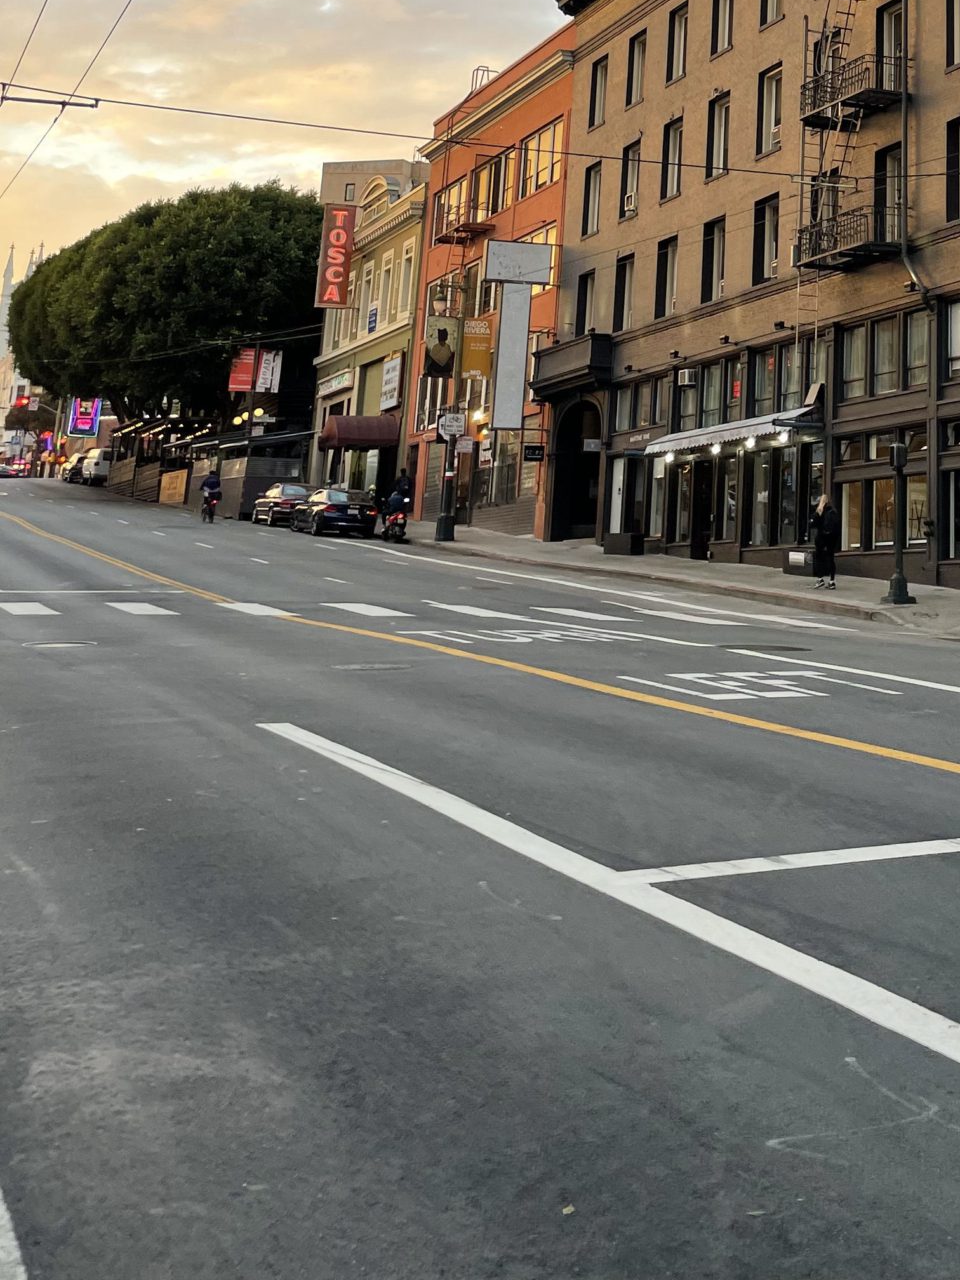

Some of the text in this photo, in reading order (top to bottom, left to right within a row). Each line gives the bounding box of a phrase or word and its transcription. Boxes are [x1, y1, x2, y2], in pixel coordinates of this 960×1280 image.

[323, 210, 349, 302] TOSCA
[464, 320, 489, 328] DIEGO
[464, 327, 491, 335] RIVERA
[396, 629, 644, 644] TURN
[616, 669, 905, 701] LEFT
